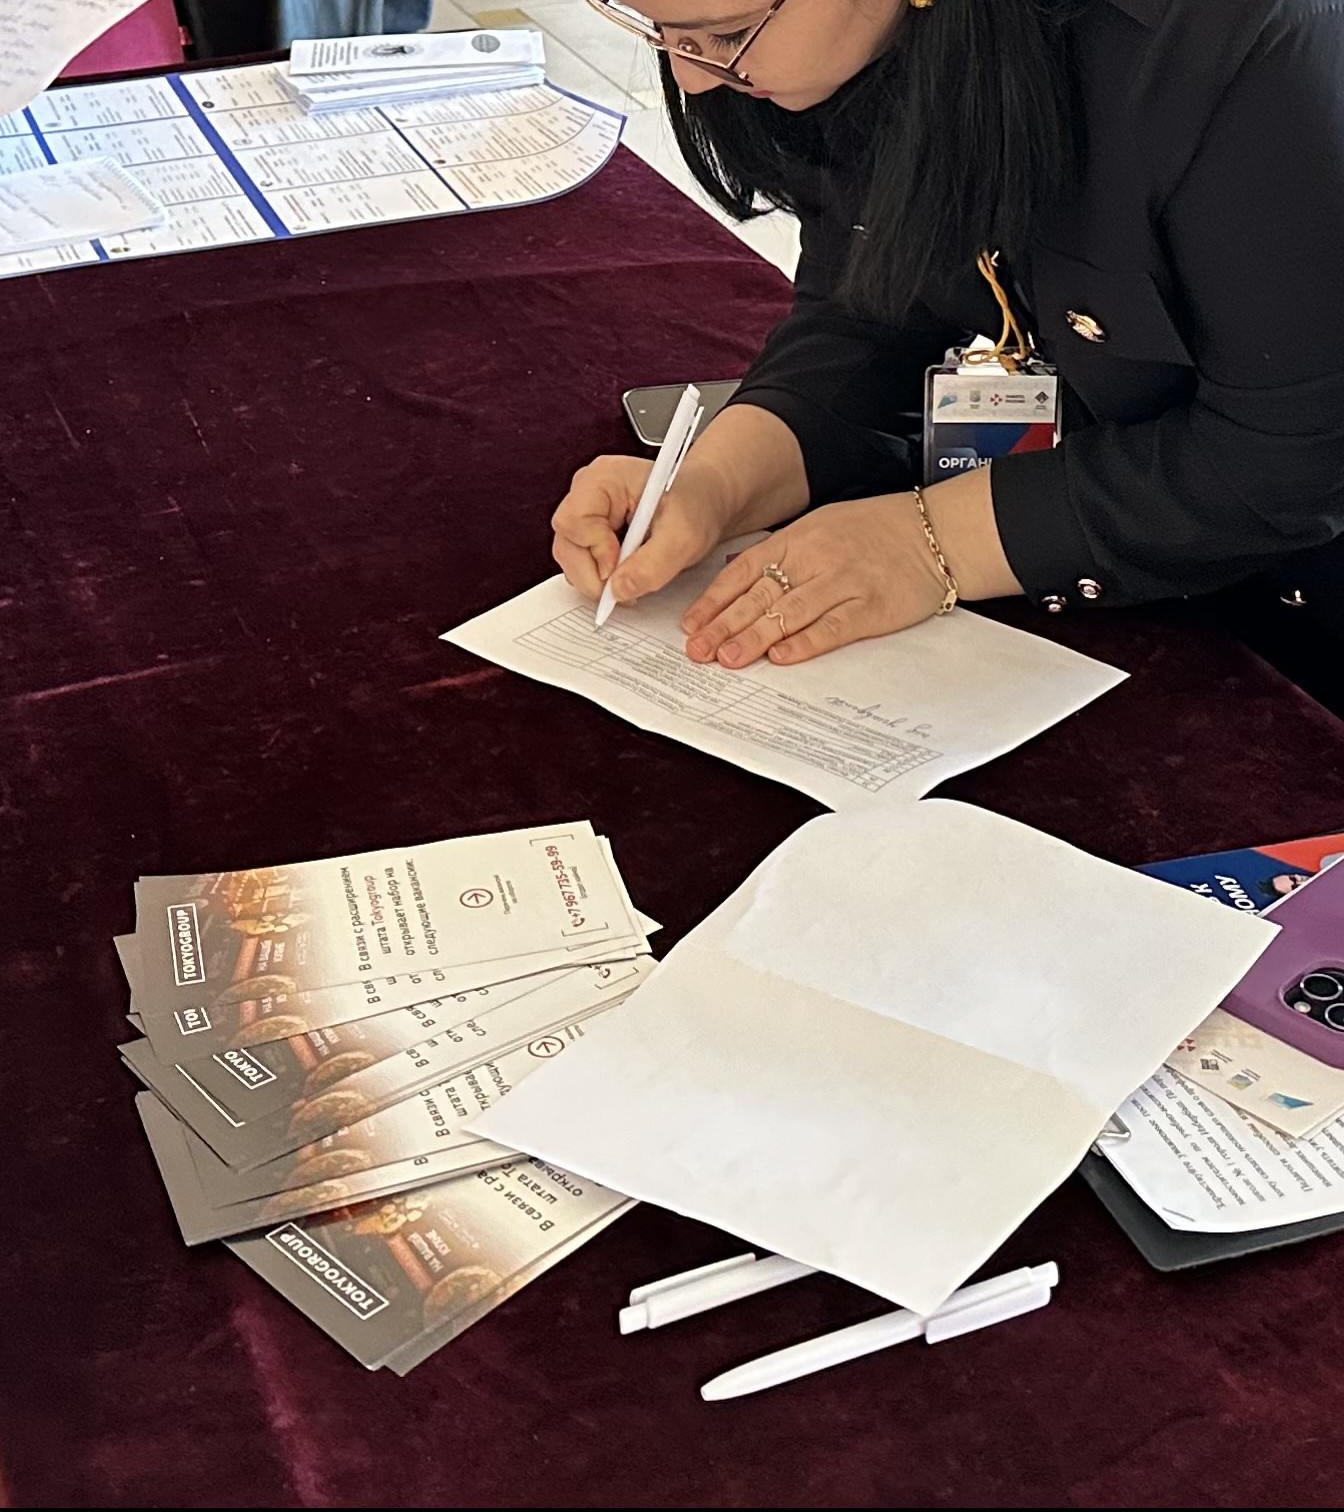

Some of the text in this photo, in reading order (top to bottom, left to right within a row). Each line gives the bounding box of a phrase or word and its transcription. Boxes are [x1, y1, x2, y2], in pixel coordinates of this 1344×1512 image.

[545, 845, 571, 893] 735-59-99
[340, 866, 362, 929] расширением
[364, 875, 391, 954] штата Tokyogroup
[385, 867, 415, 956] открывает набор на
[176, 909, 197, 980] TOKYOGROUP
[357, 937, 370, 962] связи
[417, 904, 439, 955] следующие
[358, 961, 372, 972] В
[424, 1097, 447, 1129] связи
[445, 1086, 468, 1117] штата
[504, 1190, 543, 1222] связи
[517, 1173, 558, 1205] штата
[539, 1220, 555, 1232] В
[280, 1232, 374, 1312] TOKYOGROUP
